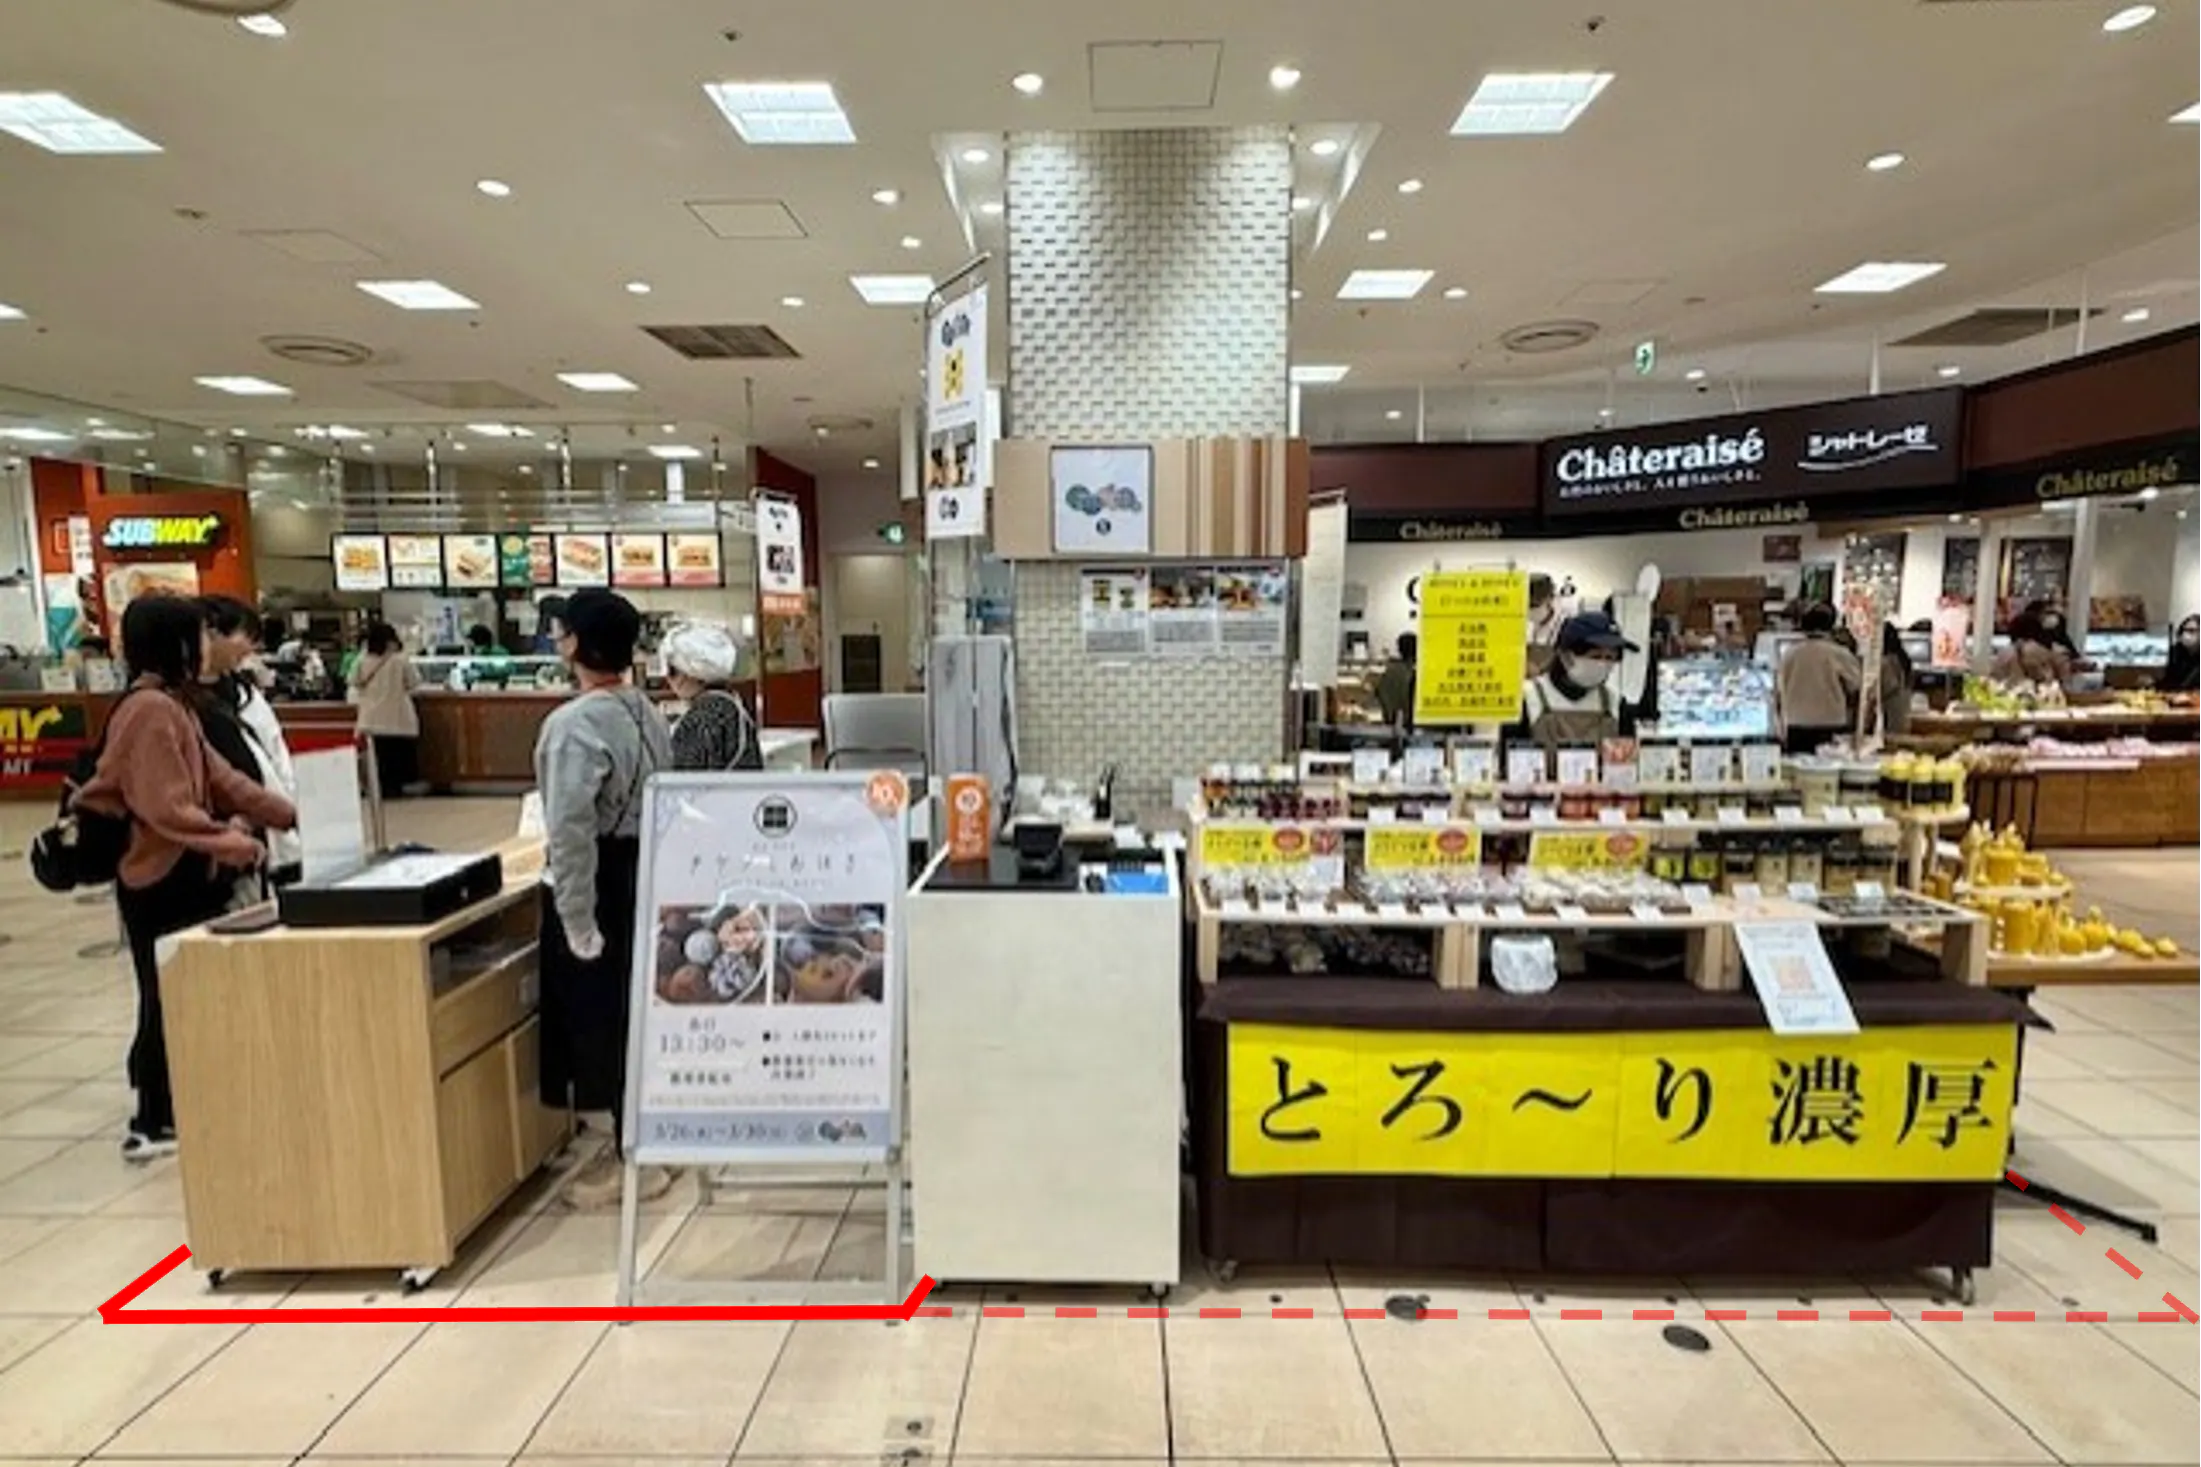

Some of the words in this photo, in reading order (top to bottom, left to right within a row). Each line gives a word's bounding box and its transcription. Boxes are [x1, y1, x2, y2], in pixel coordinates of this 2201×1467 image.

[1556, 426, 1766, 484] Châteraisé
[1808, 424, 1931, 457] シャトレーゼ
[2035, 455, 2180, 498] Châteraisé
[103, 515, 219, 546] SUBWAY
[1679, 502, 1809, 529] Châteraisé
[1258, 1055, 1999, 1149] とろ〜り濃厚
